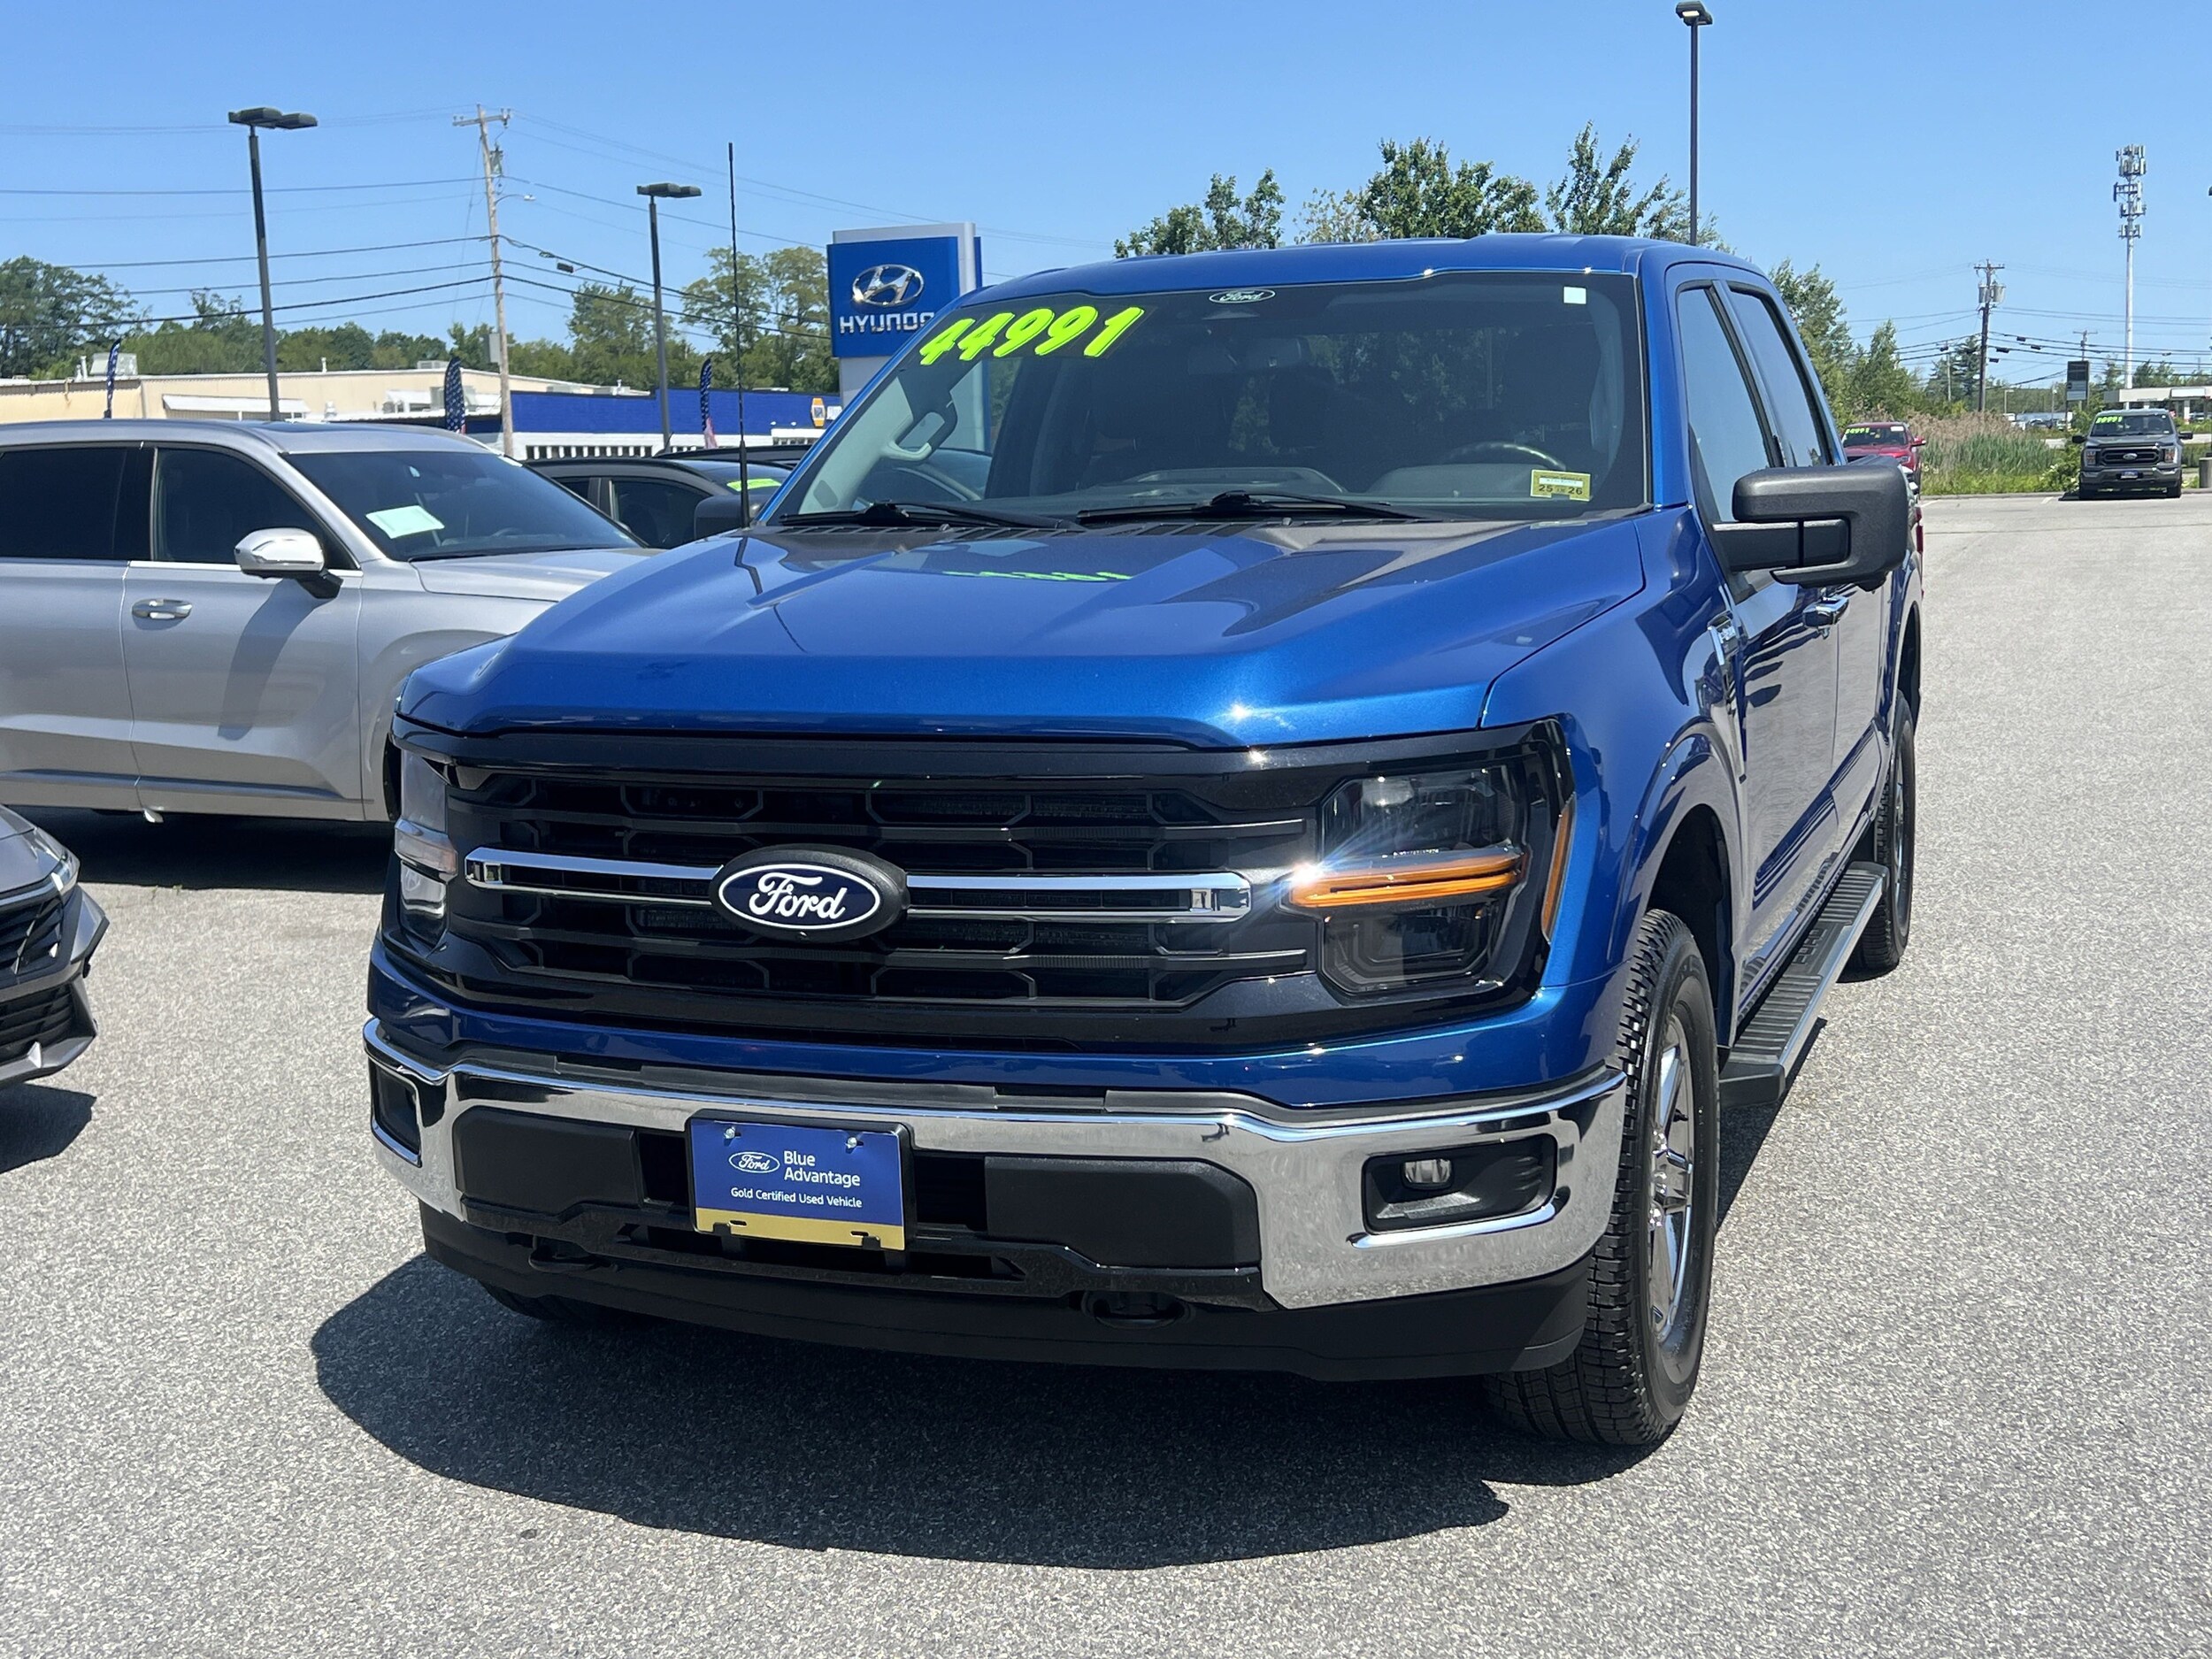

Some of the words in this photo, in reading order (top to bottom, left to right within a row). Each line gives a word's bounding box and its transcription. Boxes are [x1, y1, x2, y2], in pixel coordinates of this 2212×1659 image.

[1219, 289, 1264, 302] Ford
[839, 311, 935, 334] HYUNDA
[919, 305, 1145, 365] 44991
[749, 872, 848, 919] Ford
[738, 1155, 771, 1171] Ford
[784, 1150, 816, 1167] Blue
[784, 1167, 861, 1188] Advantage
[730, 1187, 754, 1199] Gold
[755, 1189, 796, 1203] Certified
[798, 1194, 825, 1206] Used
[826, 1195, 864, 1209] Vehicle
